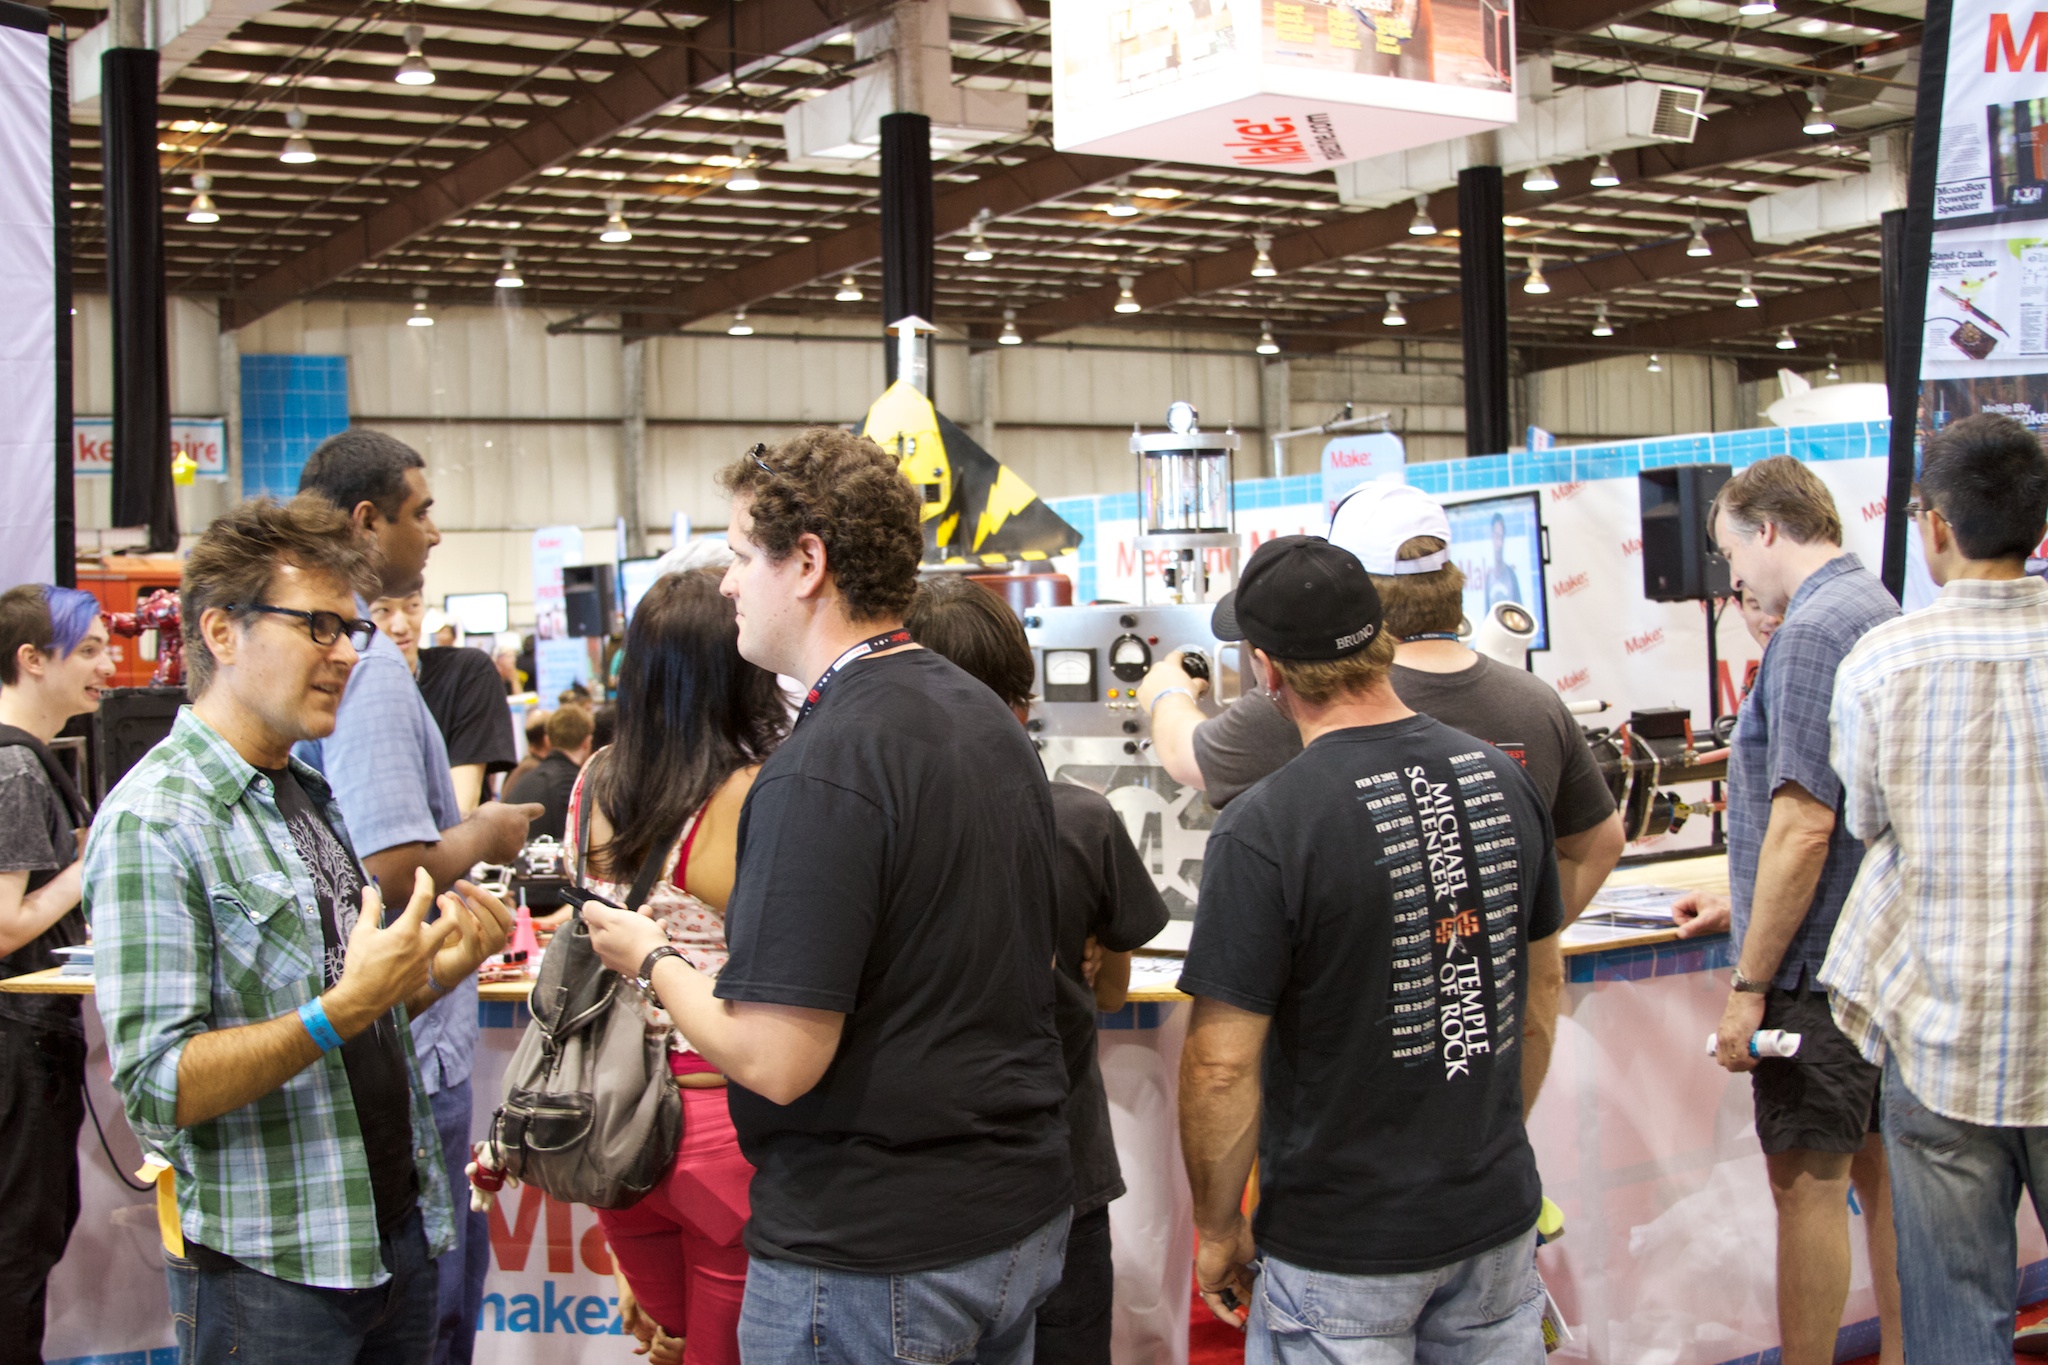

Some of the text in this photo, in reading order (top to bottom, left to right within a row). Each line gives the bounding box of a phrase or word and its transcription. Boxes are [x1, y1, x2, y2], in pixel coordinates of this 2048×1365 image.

[1222, 117, 1314, 165] Make:
[1936, 183, 1987, 195] MonoBox
[1938, 191, 1983, 204] Powered
[1938, 202, 1980, 214] Speaker
[1961, 260, 1997, 268] Counter
[1982, 403, 2031, 414] Nellie Bly
[1331, 450, 1372, 469] Make:
[1553, 571, 1589, 598] Make:
[1335, 623, 1375, 650] BRUNO
[1624, 627, 1664, 655] Make:
[1556, 667, 1591, 694] Make:
[1449, 755, 1465, 765] MAR
[1355, 778, 1372, 788] FEB
[1380, 771, 1398, 782] 2012
[1457, 775, 1475, 786] MAR
[1366, 799, 1383, 811] FEB
[1391, 793, 1407, 804] 2012
[1463, 797, 1482, 808] MAR
[1375, 822, 1392, 833] FEB
[1469, 819, 1487, 830] MAR
[1404, 766, 1449, 902] SCHENKER
[1430, 783, 1468, 898] MICHAEL
[1383, 844, 1398, 856] FEB
[1474, 842, 1492, 853] MAR
[1479, 865, 1496, 875] MAR
[1482, 887, 1499, 898] MAR
[1485, 910, 1502, 920] MAR
[1392, 959, 1410, 969] FEB
[1440, 963, 1458, 996] OF
[1393, 982, 1411, 992] FEB
[1394, 1004, 1412, 1013] FEB
[1456, 956, 1490, 1056] TEMPLE
[1392, 1026, 1412, 1036] MAR
[1441, 1001, 1469, 1081] ROCK
[1392, 1047, 1412, 1058] MAR
